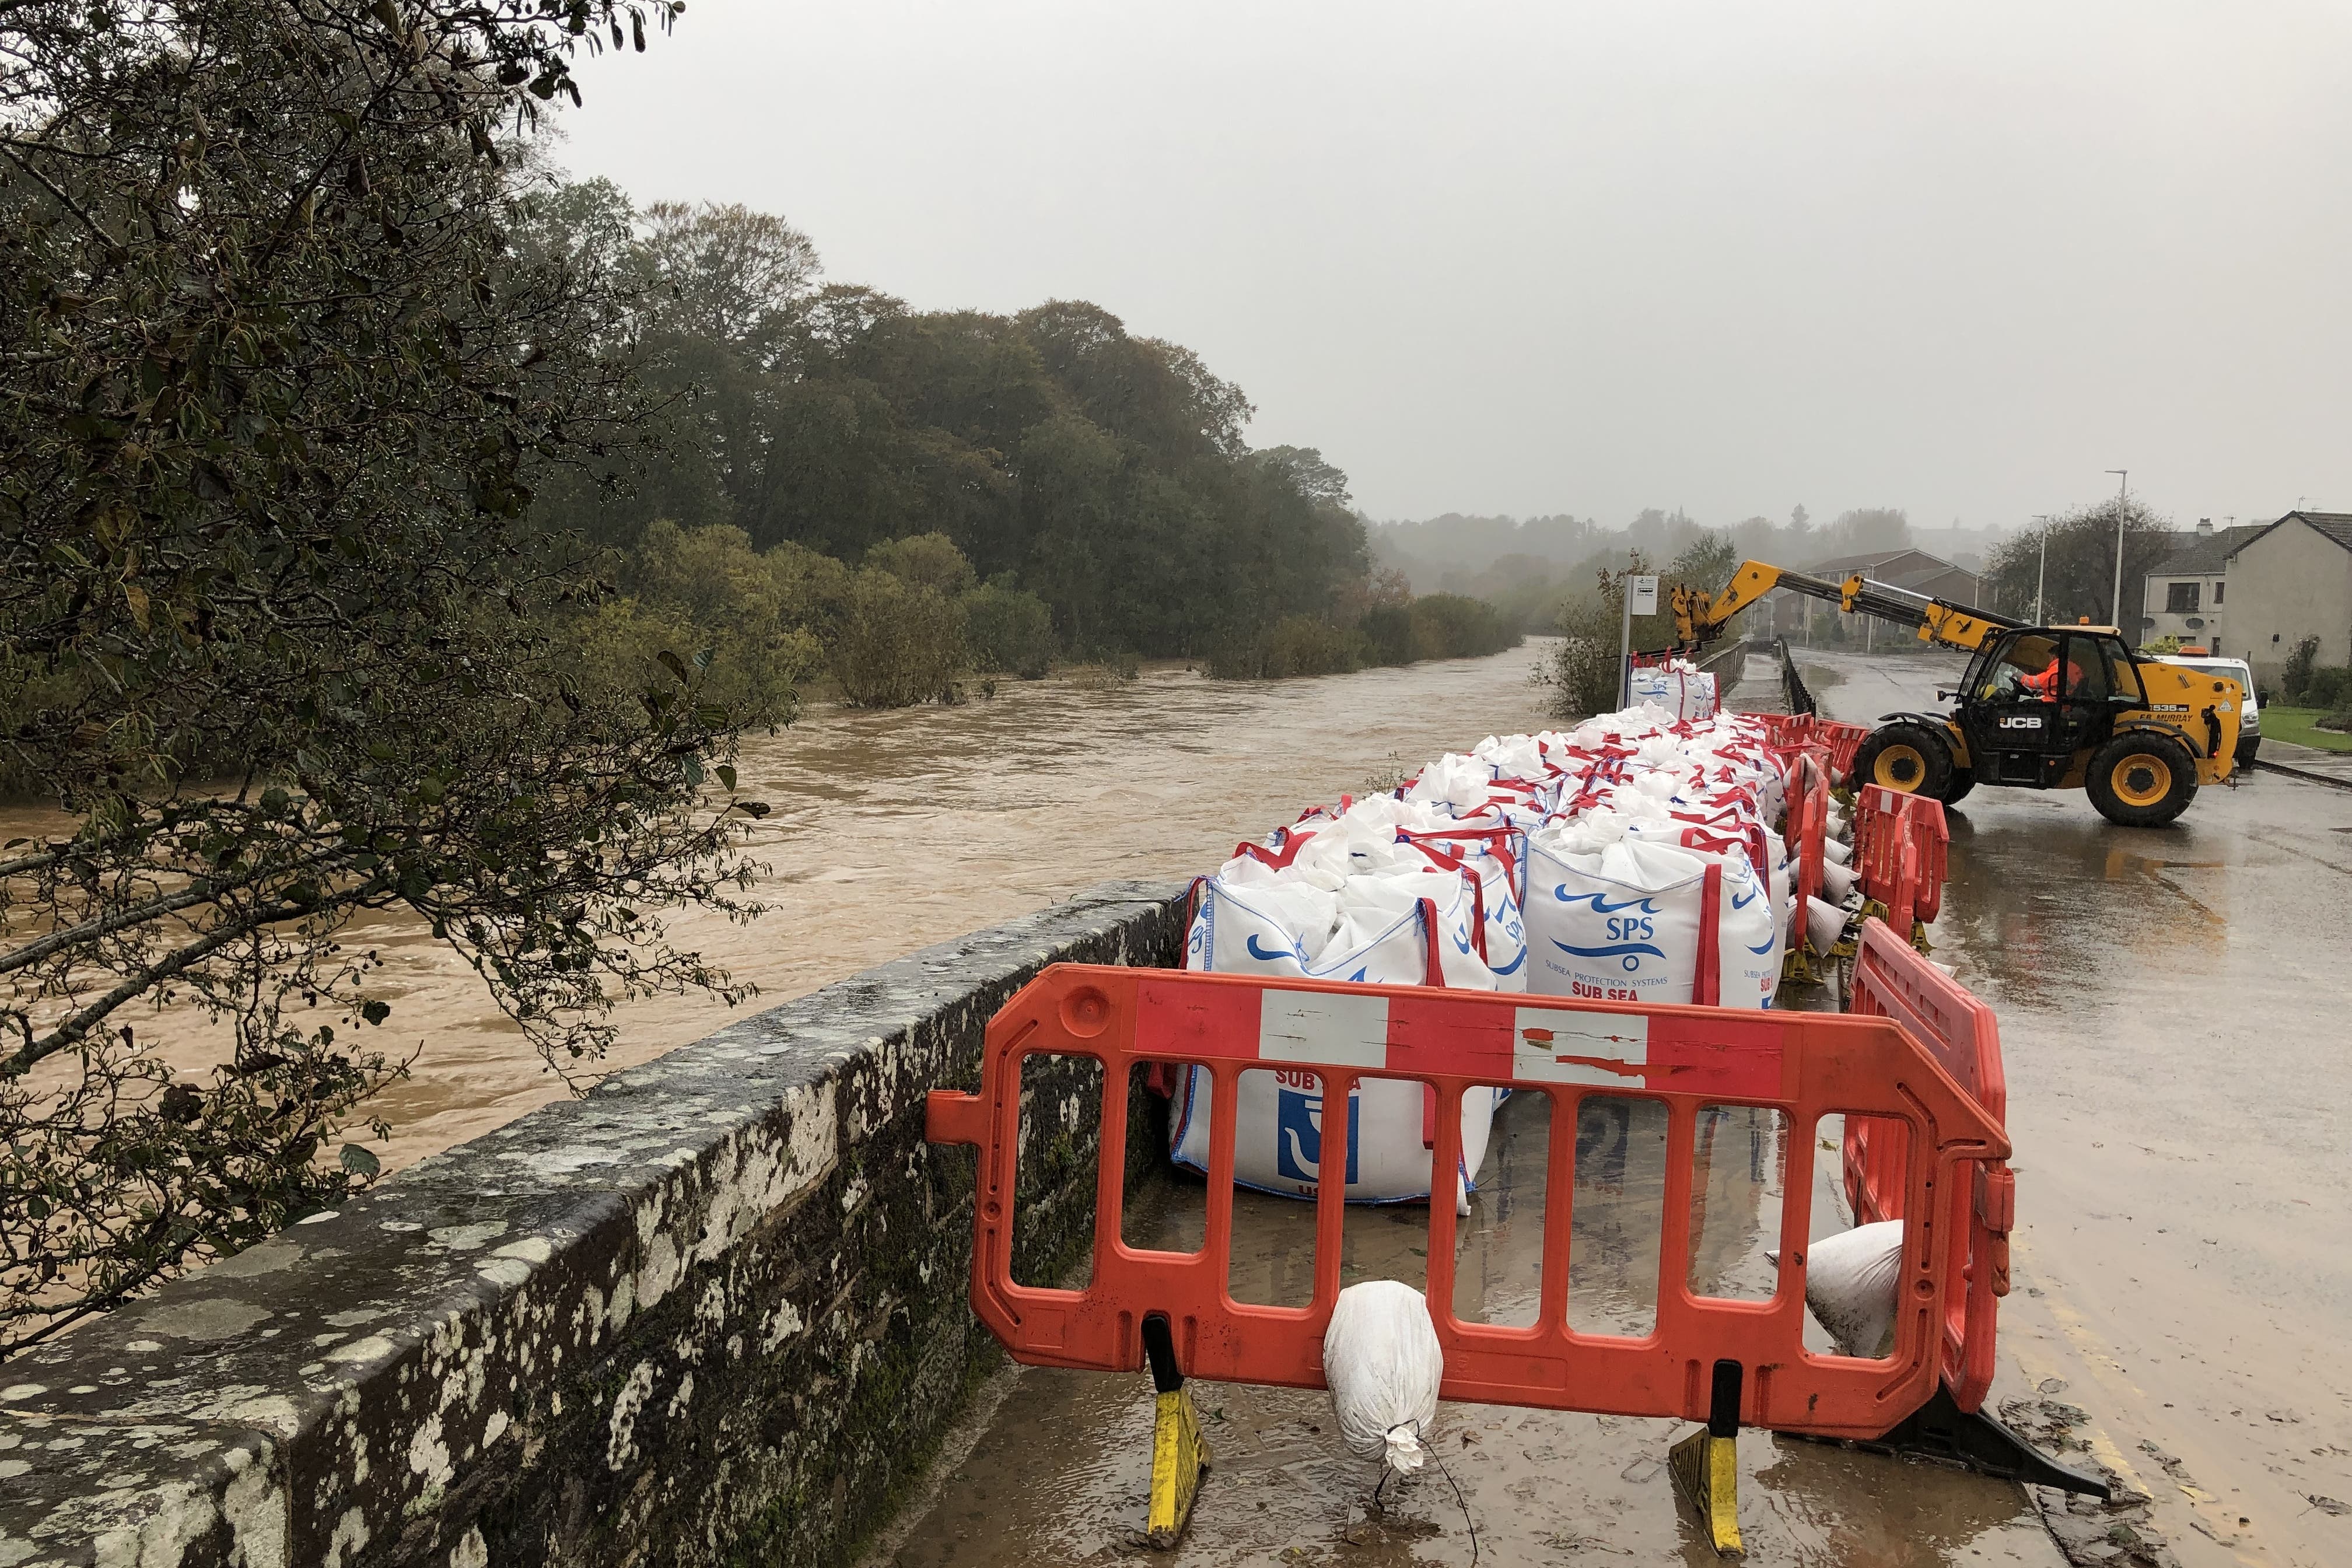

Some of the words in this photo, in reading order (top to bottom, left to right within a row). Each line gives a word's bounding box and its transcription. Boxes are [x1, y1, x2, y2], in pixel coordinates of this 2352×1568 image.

[1999, 717, 2042, 728] JCB
[2157, 714, 2193, 722] MURRAY
[1606, 916, 1654, 940] SPS
[1545, 959, 1571, 977] SUBSEA
[1574, 972, 1627, 987] PROTECTION
[1632, 976, 1667, 987] SYSTEMS
[1572, 981, 1602, 999] SUB
[1607, 988, 1638, 1002] SEA
[1275, 1070, 1315, 1090] SUB
